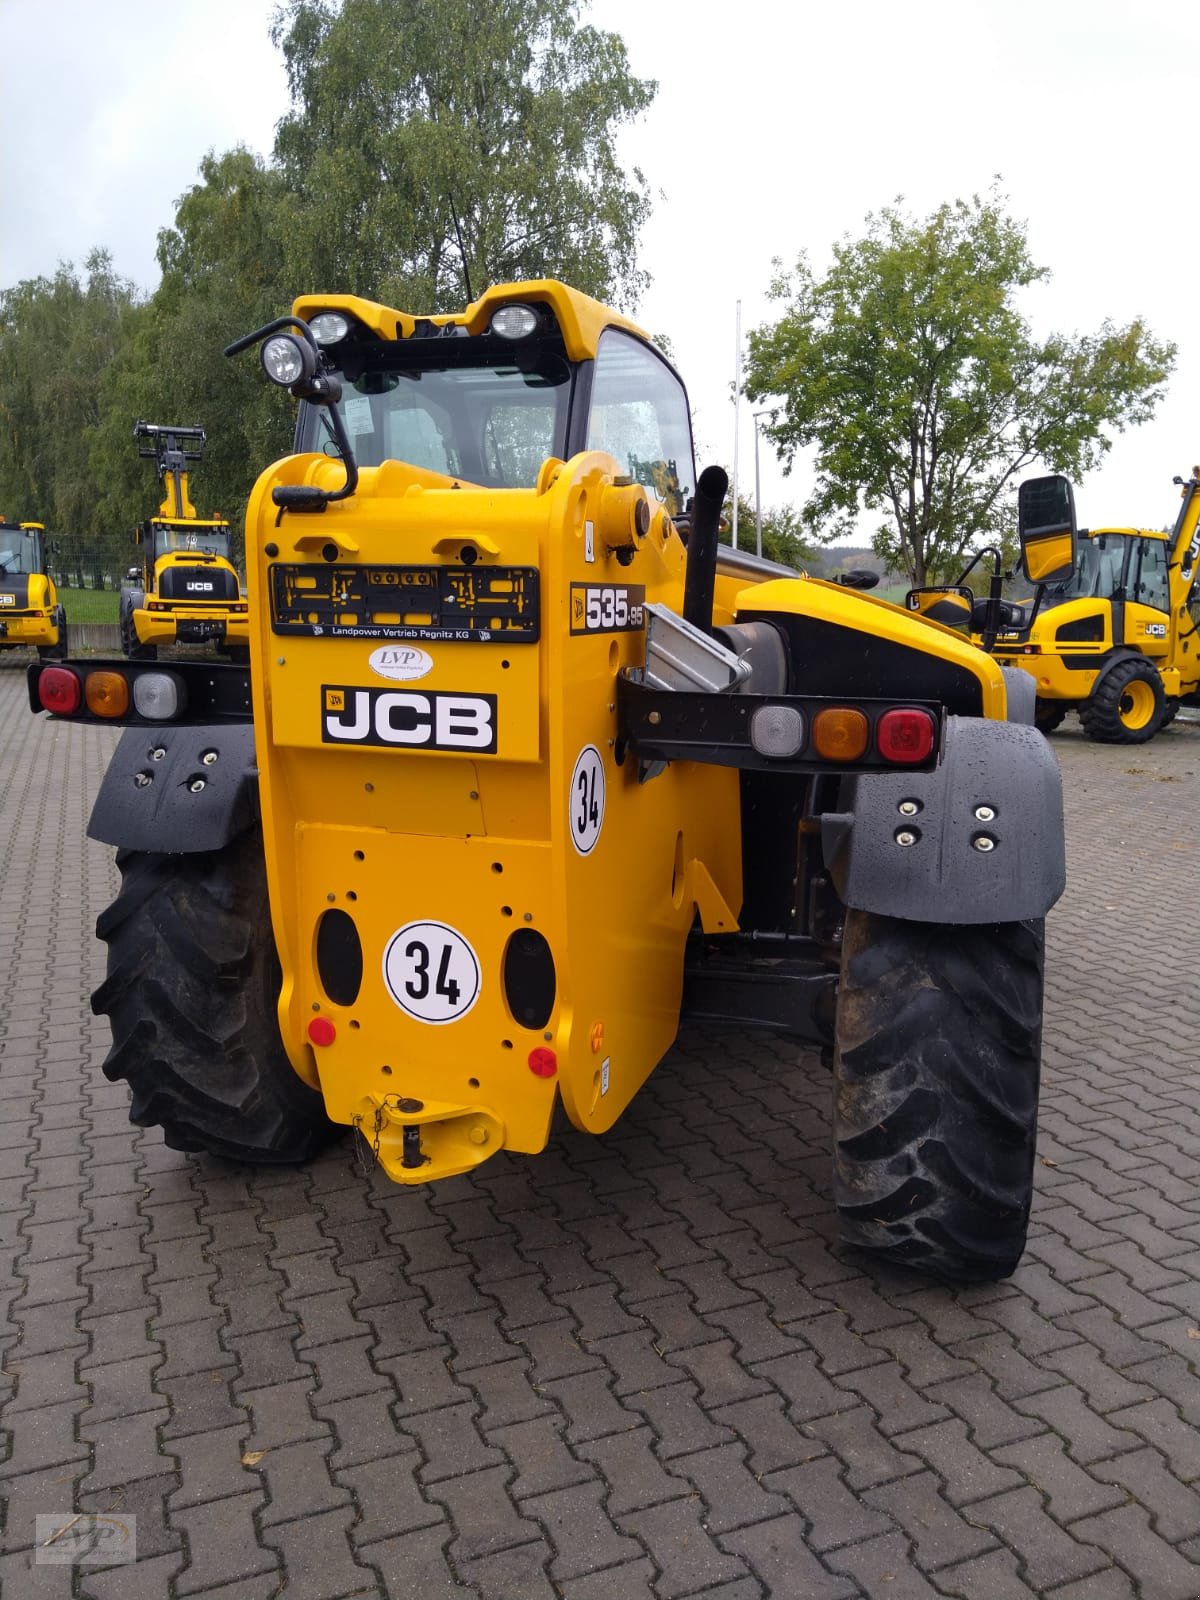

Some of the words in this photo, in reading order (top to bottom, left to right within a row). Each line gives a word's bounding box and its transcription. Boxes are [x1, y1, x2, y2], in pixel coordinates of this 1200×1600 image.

[186, 582, 213, 591] JCB
[332, 626, 381, 637] Landpower
[383, 628, 418, 637] Vertrieb
[420, 629, 453, 640] Pegnitz
[455, 631, 469, 639] KG
[1145, 624, 1166, 635] JCB
[380, 651, 416, 664] LVP
[326, 691, 493, 748] JCB
[578, 766, 598, 834] 34
[405, 940, 460, 1006] 34
